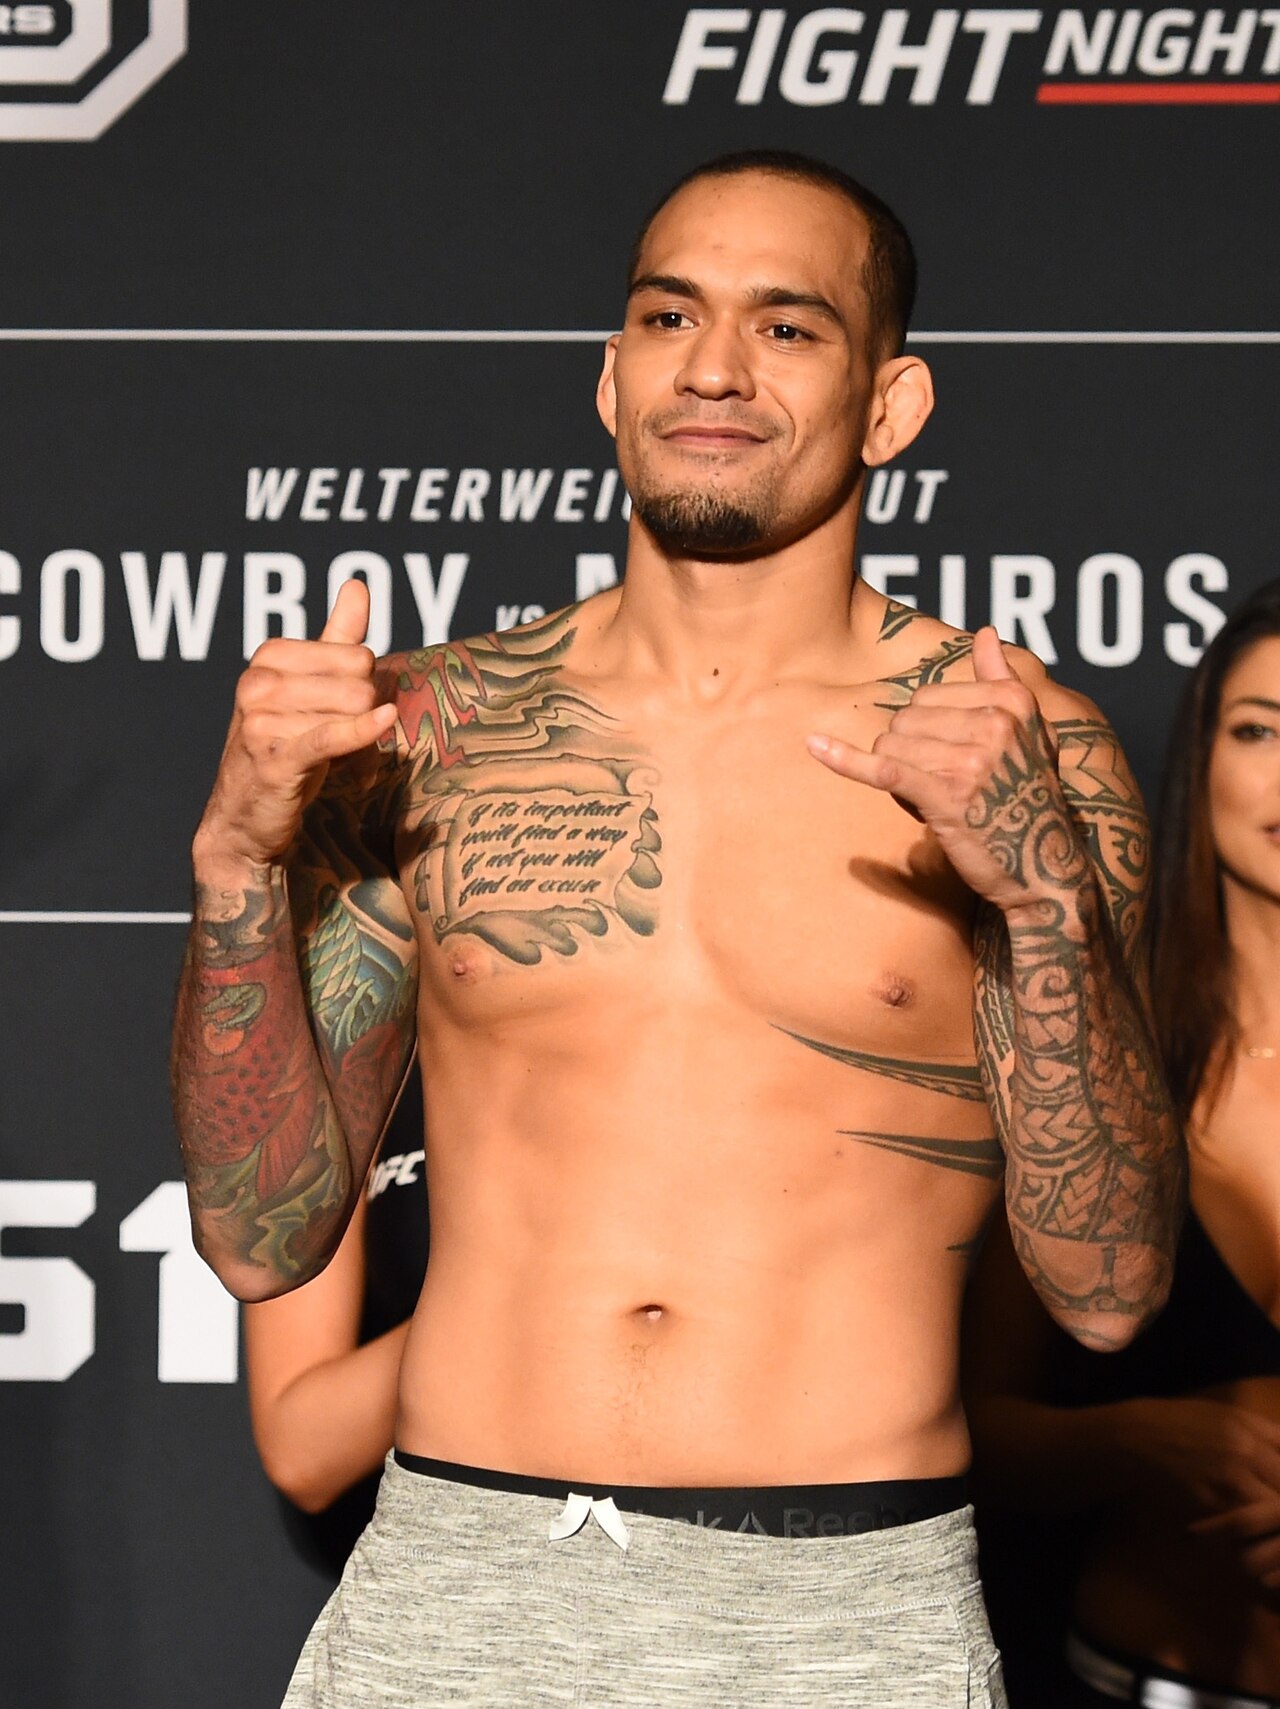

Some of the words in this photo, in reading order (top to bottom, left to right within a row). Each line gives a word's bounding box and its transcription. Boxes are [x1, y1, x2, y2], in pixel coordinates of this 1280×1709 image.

[661, 8, 1042, 105] FIGHT
[244, 467, 632, 522] WELTERWEI
[865, 469, 949, 524] UT
[523, 799, 634, 823] important
[511, 824, 568, 849] find
[566, 828, 583, 841] a
[585, 826, 628, 851] way
[461, 851, 487, 880] if
[485, 848, 526, 868] not
[518, 852, 560, 876] you
[562, 848, 608, 868] will
[458, 874, 511, 908] find
[506, 878, 537, 894] an
[538, 878, 602, 894] excuse
